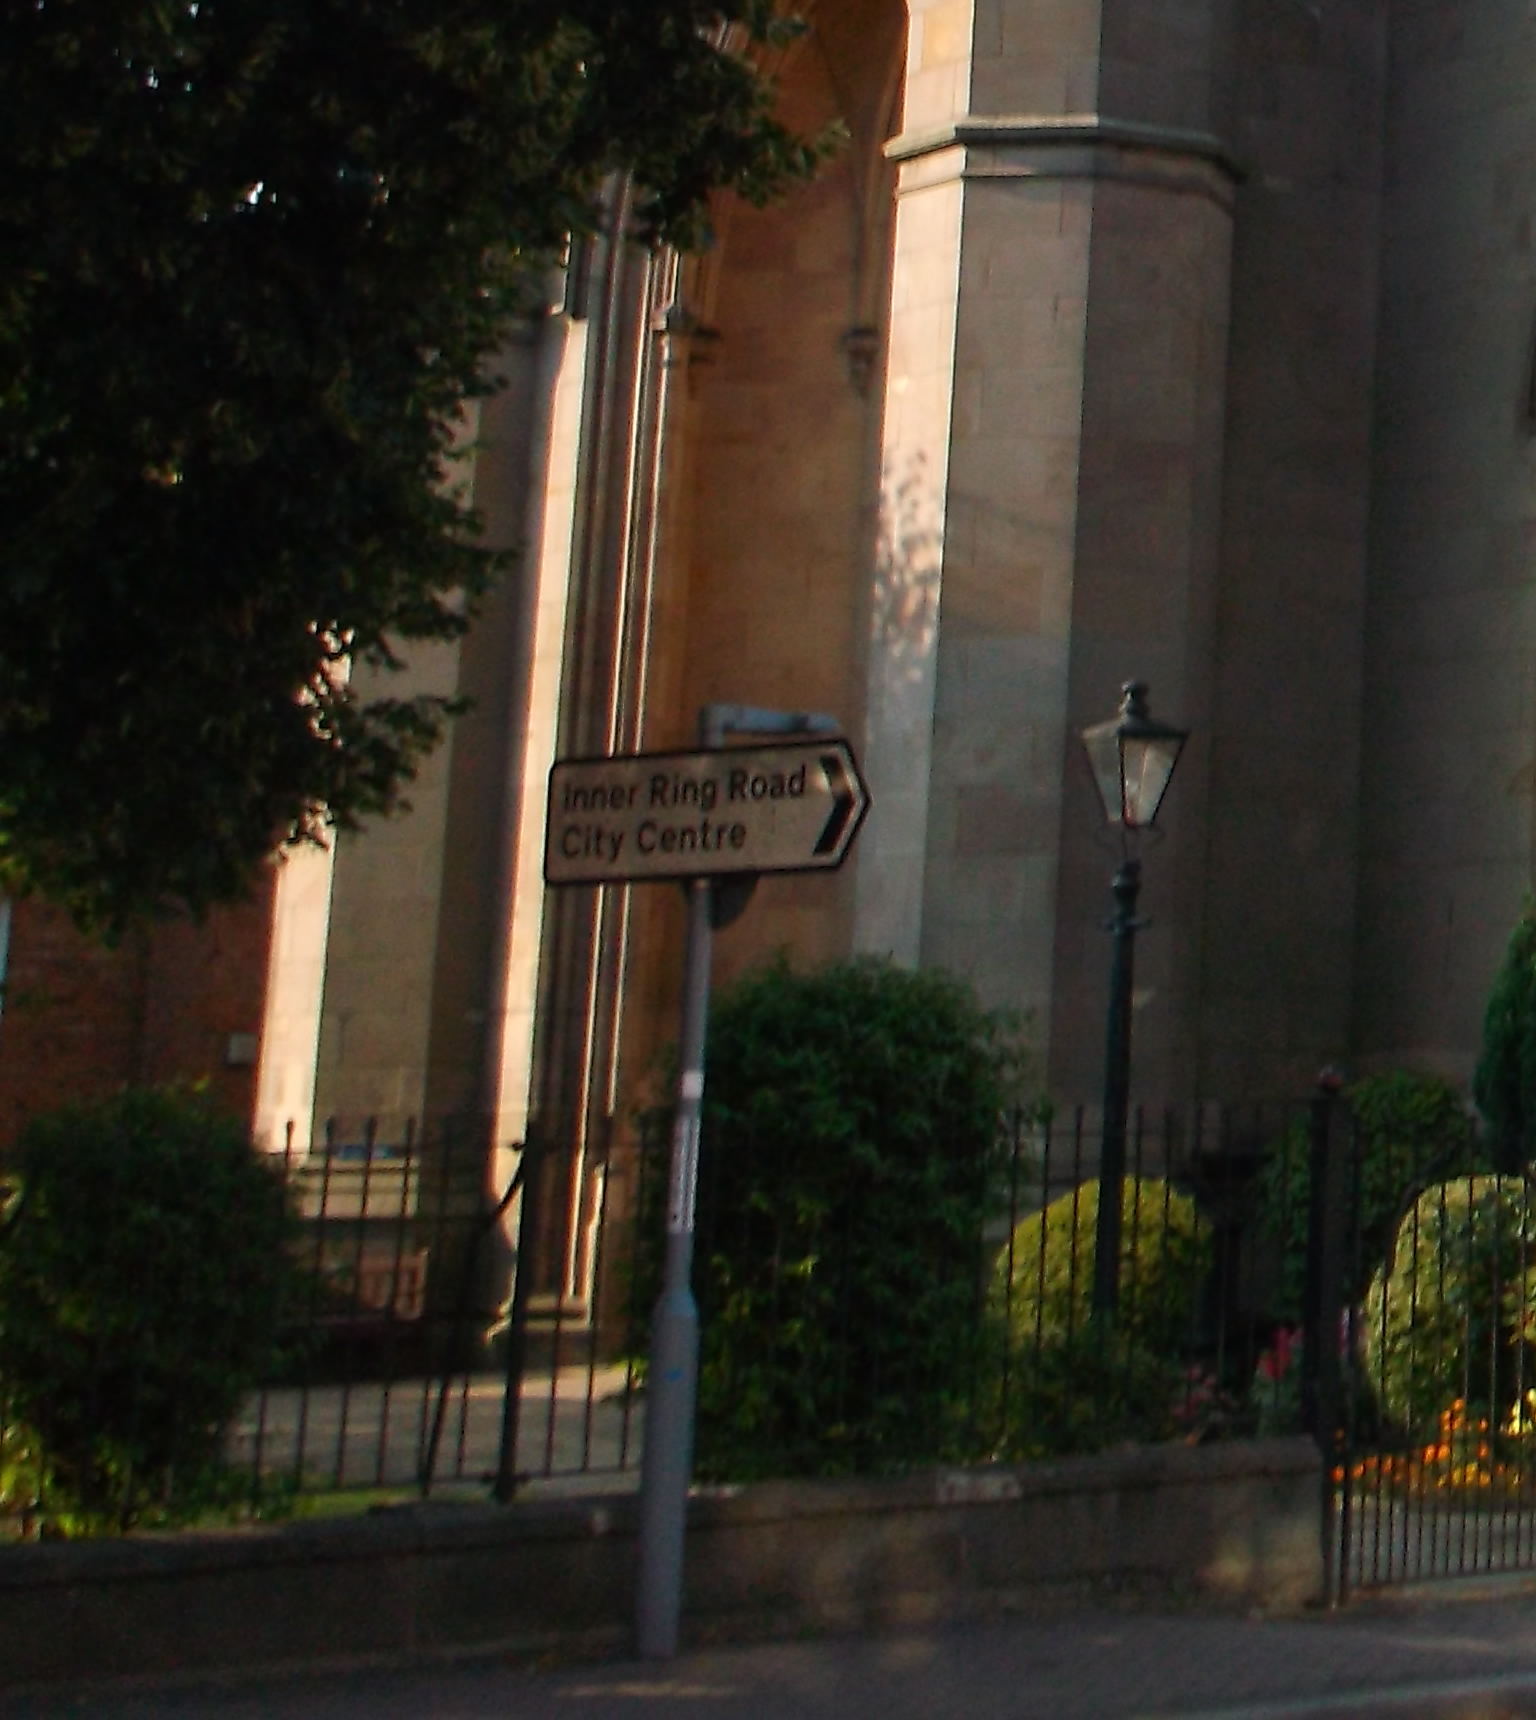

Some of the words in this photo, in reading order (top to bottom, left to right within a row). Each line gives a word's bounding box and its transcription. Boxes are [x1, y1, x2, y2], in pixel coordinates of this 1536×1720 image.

[562, 782, 638, 812] Inner
[650, 774, 717, 811] Ring
[728, 763, 807, 802] Road
[561, 824, 624, 863] City
[637, 818, 748, 854] Centre
